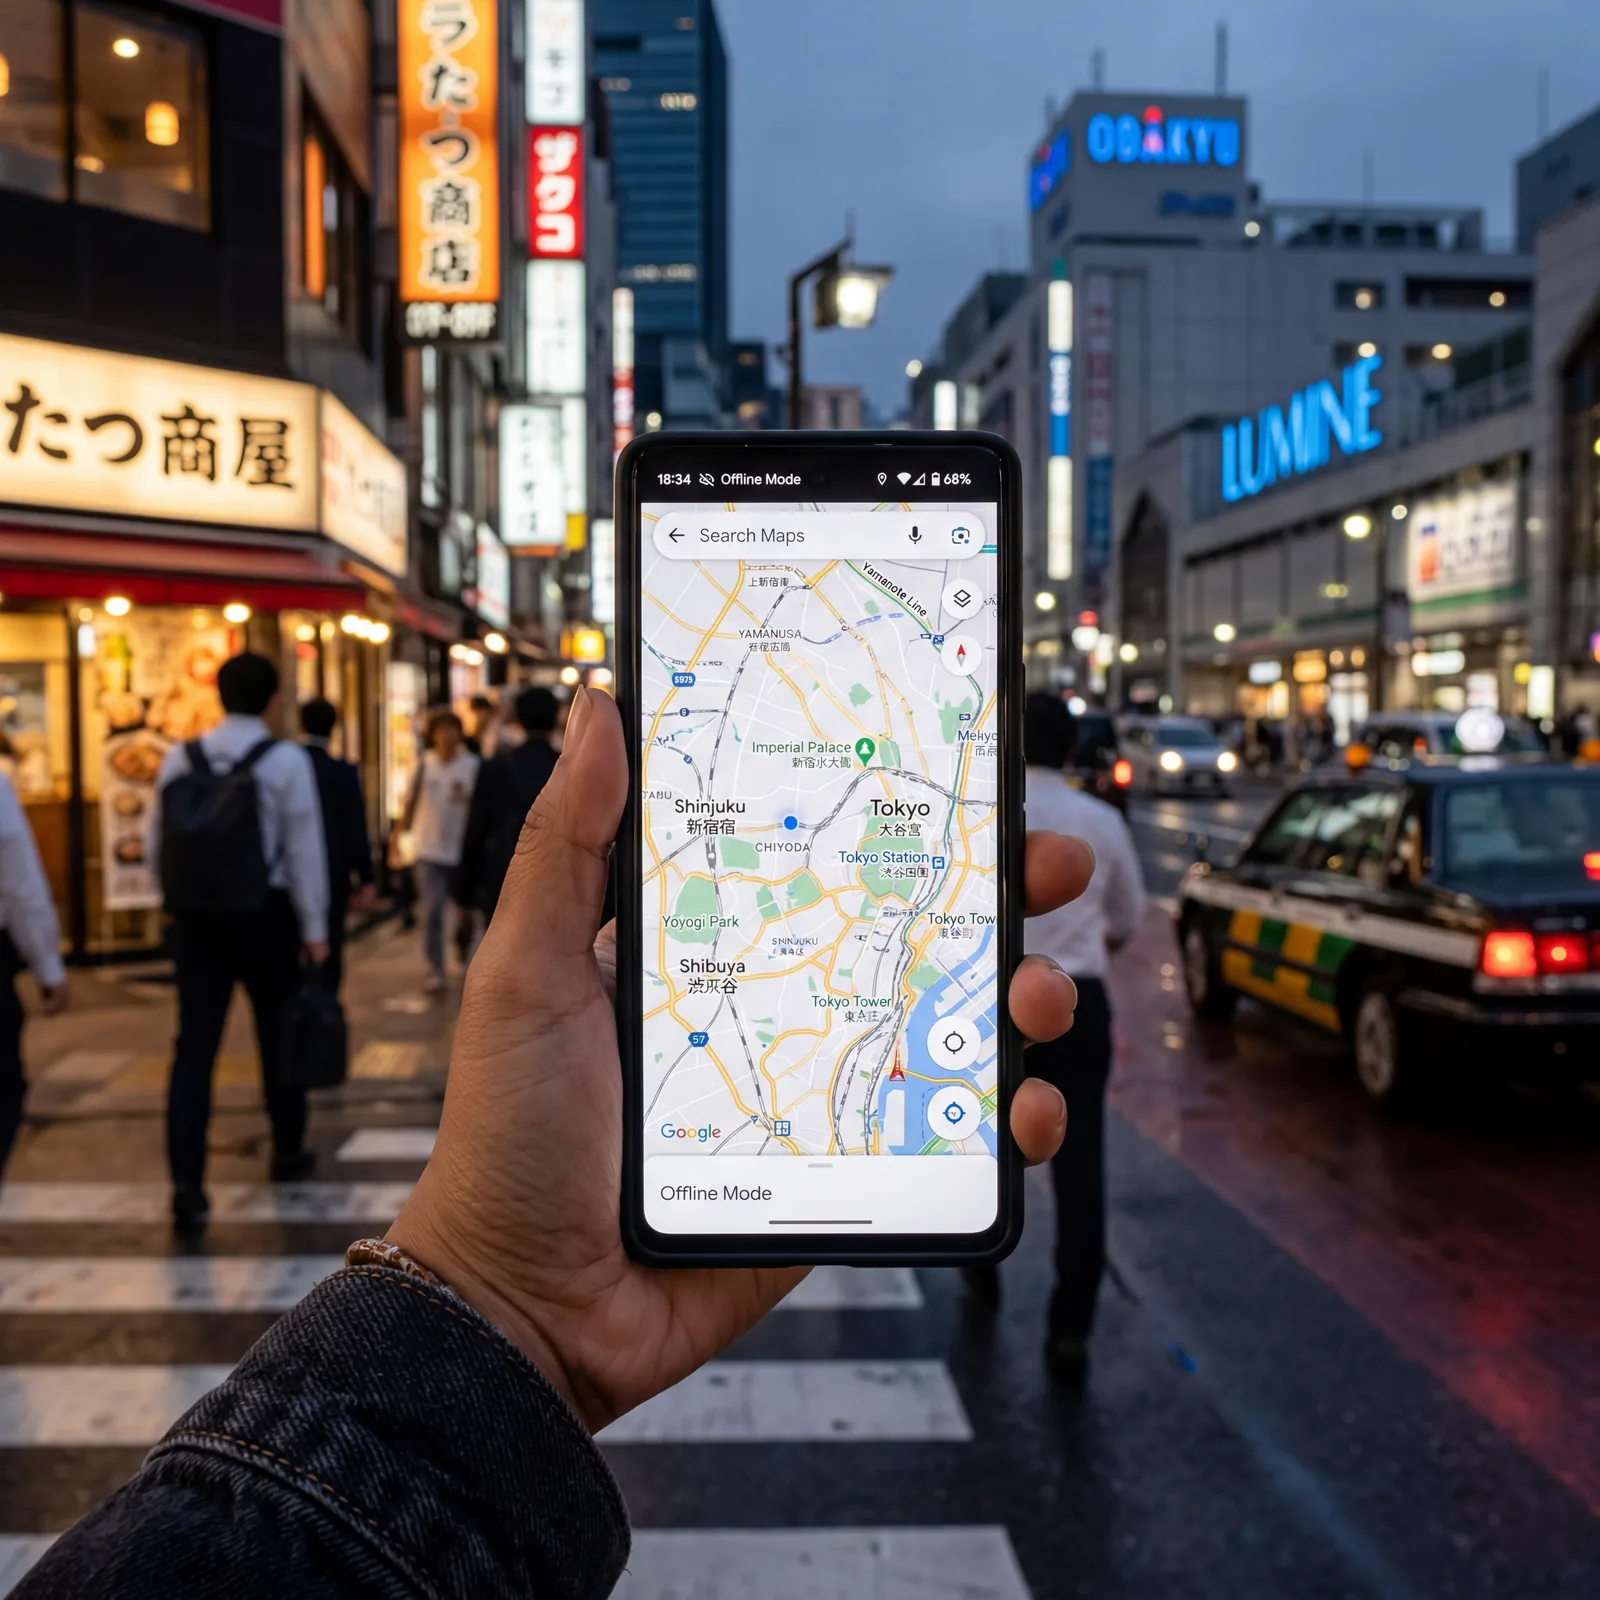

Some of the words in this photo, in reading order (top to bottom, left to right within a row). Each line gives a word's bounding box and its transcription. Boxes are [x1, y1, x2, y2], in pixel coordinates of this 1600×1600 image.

[4, 383, 293, 489] たつ商屋
[1221, 354, 1383, 502] LUMINE
[657, 474, 691, 485] 18:34
[721, 473, 762, 486] Offline
[765, 474, 801, 486] Mode
[944, 473, 971, 485] 68%
[700, 528, 756, 543] Search
[761, 529, 805, 546] Maps
[862, 561, 908, 600] Yamanote
[907, 596, 927, 618] Line
[738, 629, 802, 639] YAMANUSA
[752, 741, 804, 755] Imperial
[808, 741, 852, 753] Palace
[674, 798, 746, 817] Shinjuku
[870, 800, 931, 821] Tokyo
[686, 818, 736, 836] 新宿宿
[755, 842, 811, 852] CHIYODA
[838, 851, 879, 865] Tokyo
[882, 851, 930, 863] Station
[662, 915, 706, 931] Yoyogi
[709, 915, 739, 928] Park
[927, 912, 965, 926] Tokyo
[970, 913, 996, 924] Tow
[680, 958, 746, 976] Shibuya
[812, 995, 850, 1010] Tokyo
[853, 996, 892, 1007] Tower
[692, 1035, 706, 1044] 57
[660, 1123, 721, 1143] Google
[660, 1185, 718, 1202] Offline
[723, 1185, 772, 1202] Mode
